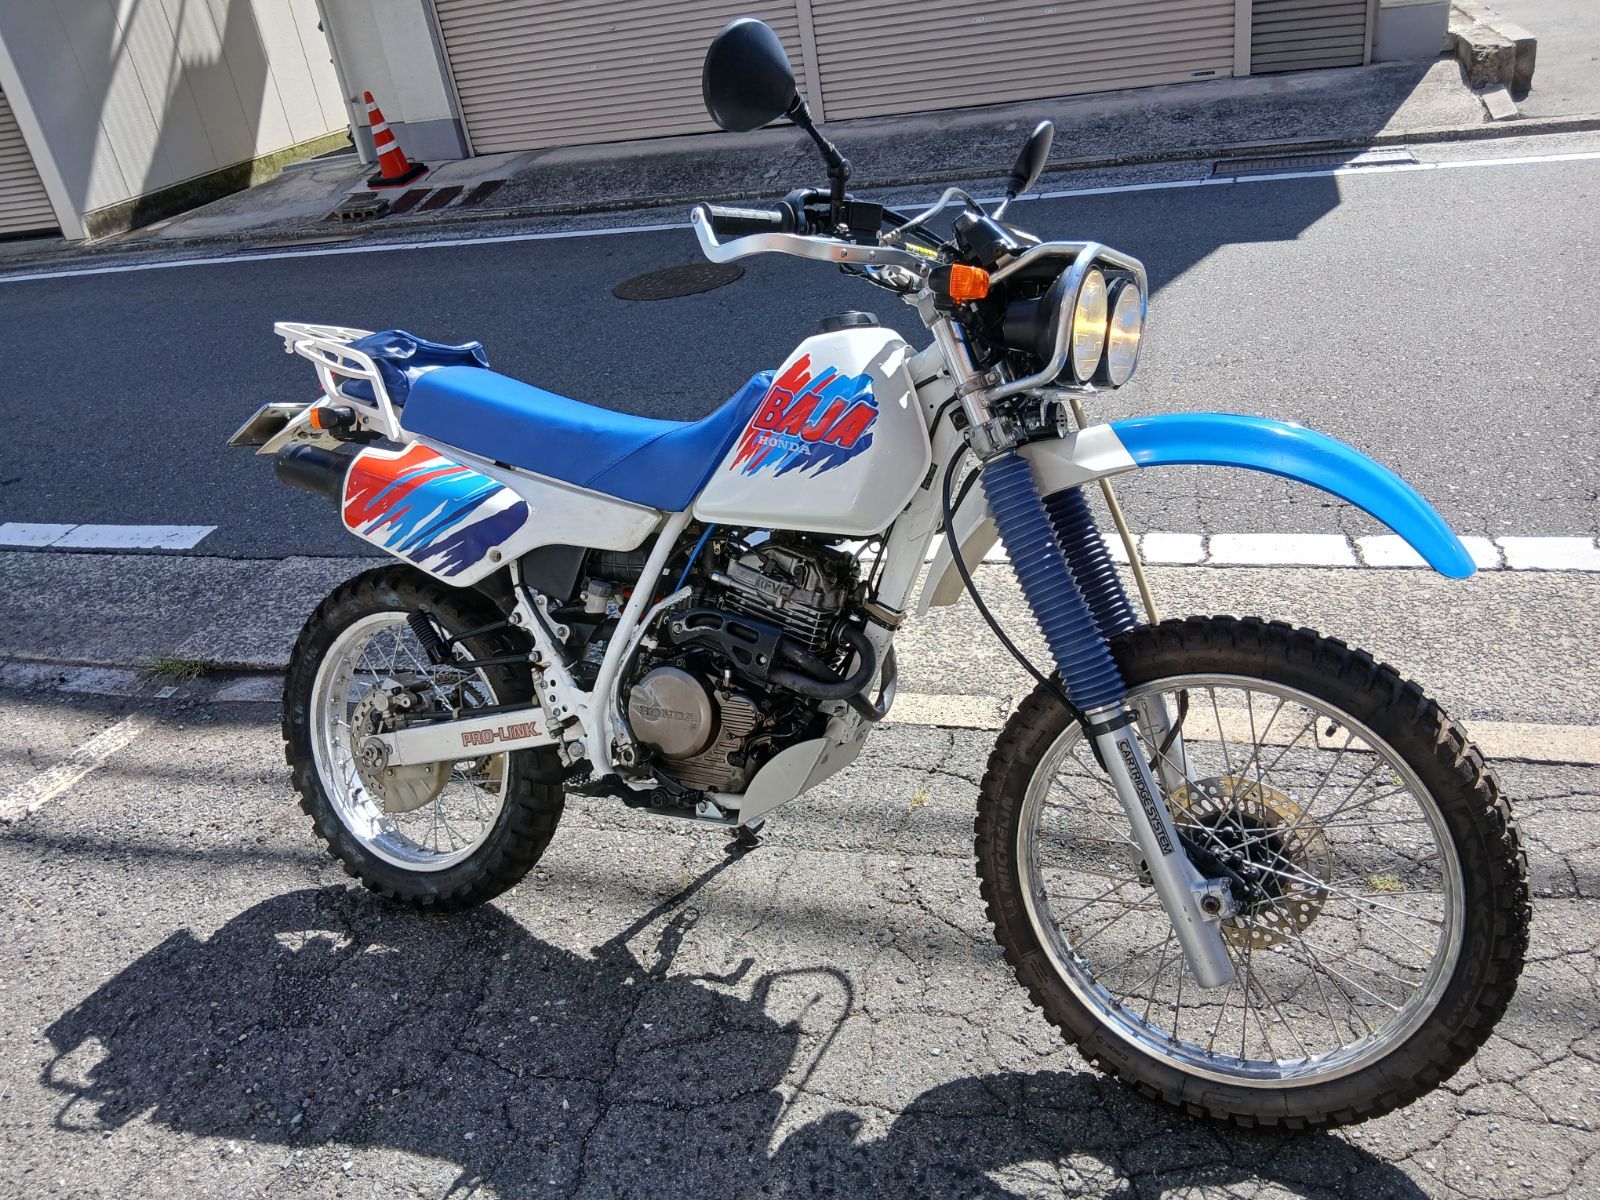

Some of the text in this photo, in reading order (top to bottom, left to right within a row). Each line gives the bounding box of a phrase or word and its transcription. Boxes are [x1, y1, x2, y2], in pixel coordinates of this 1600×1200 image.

[753, 386, 878, 448] BAJA
[758, 436, 811, 455] HONDA
[461, 721, 537, 747] PRO-LINK
[997, 797, 1014, 893] MICHELIN
